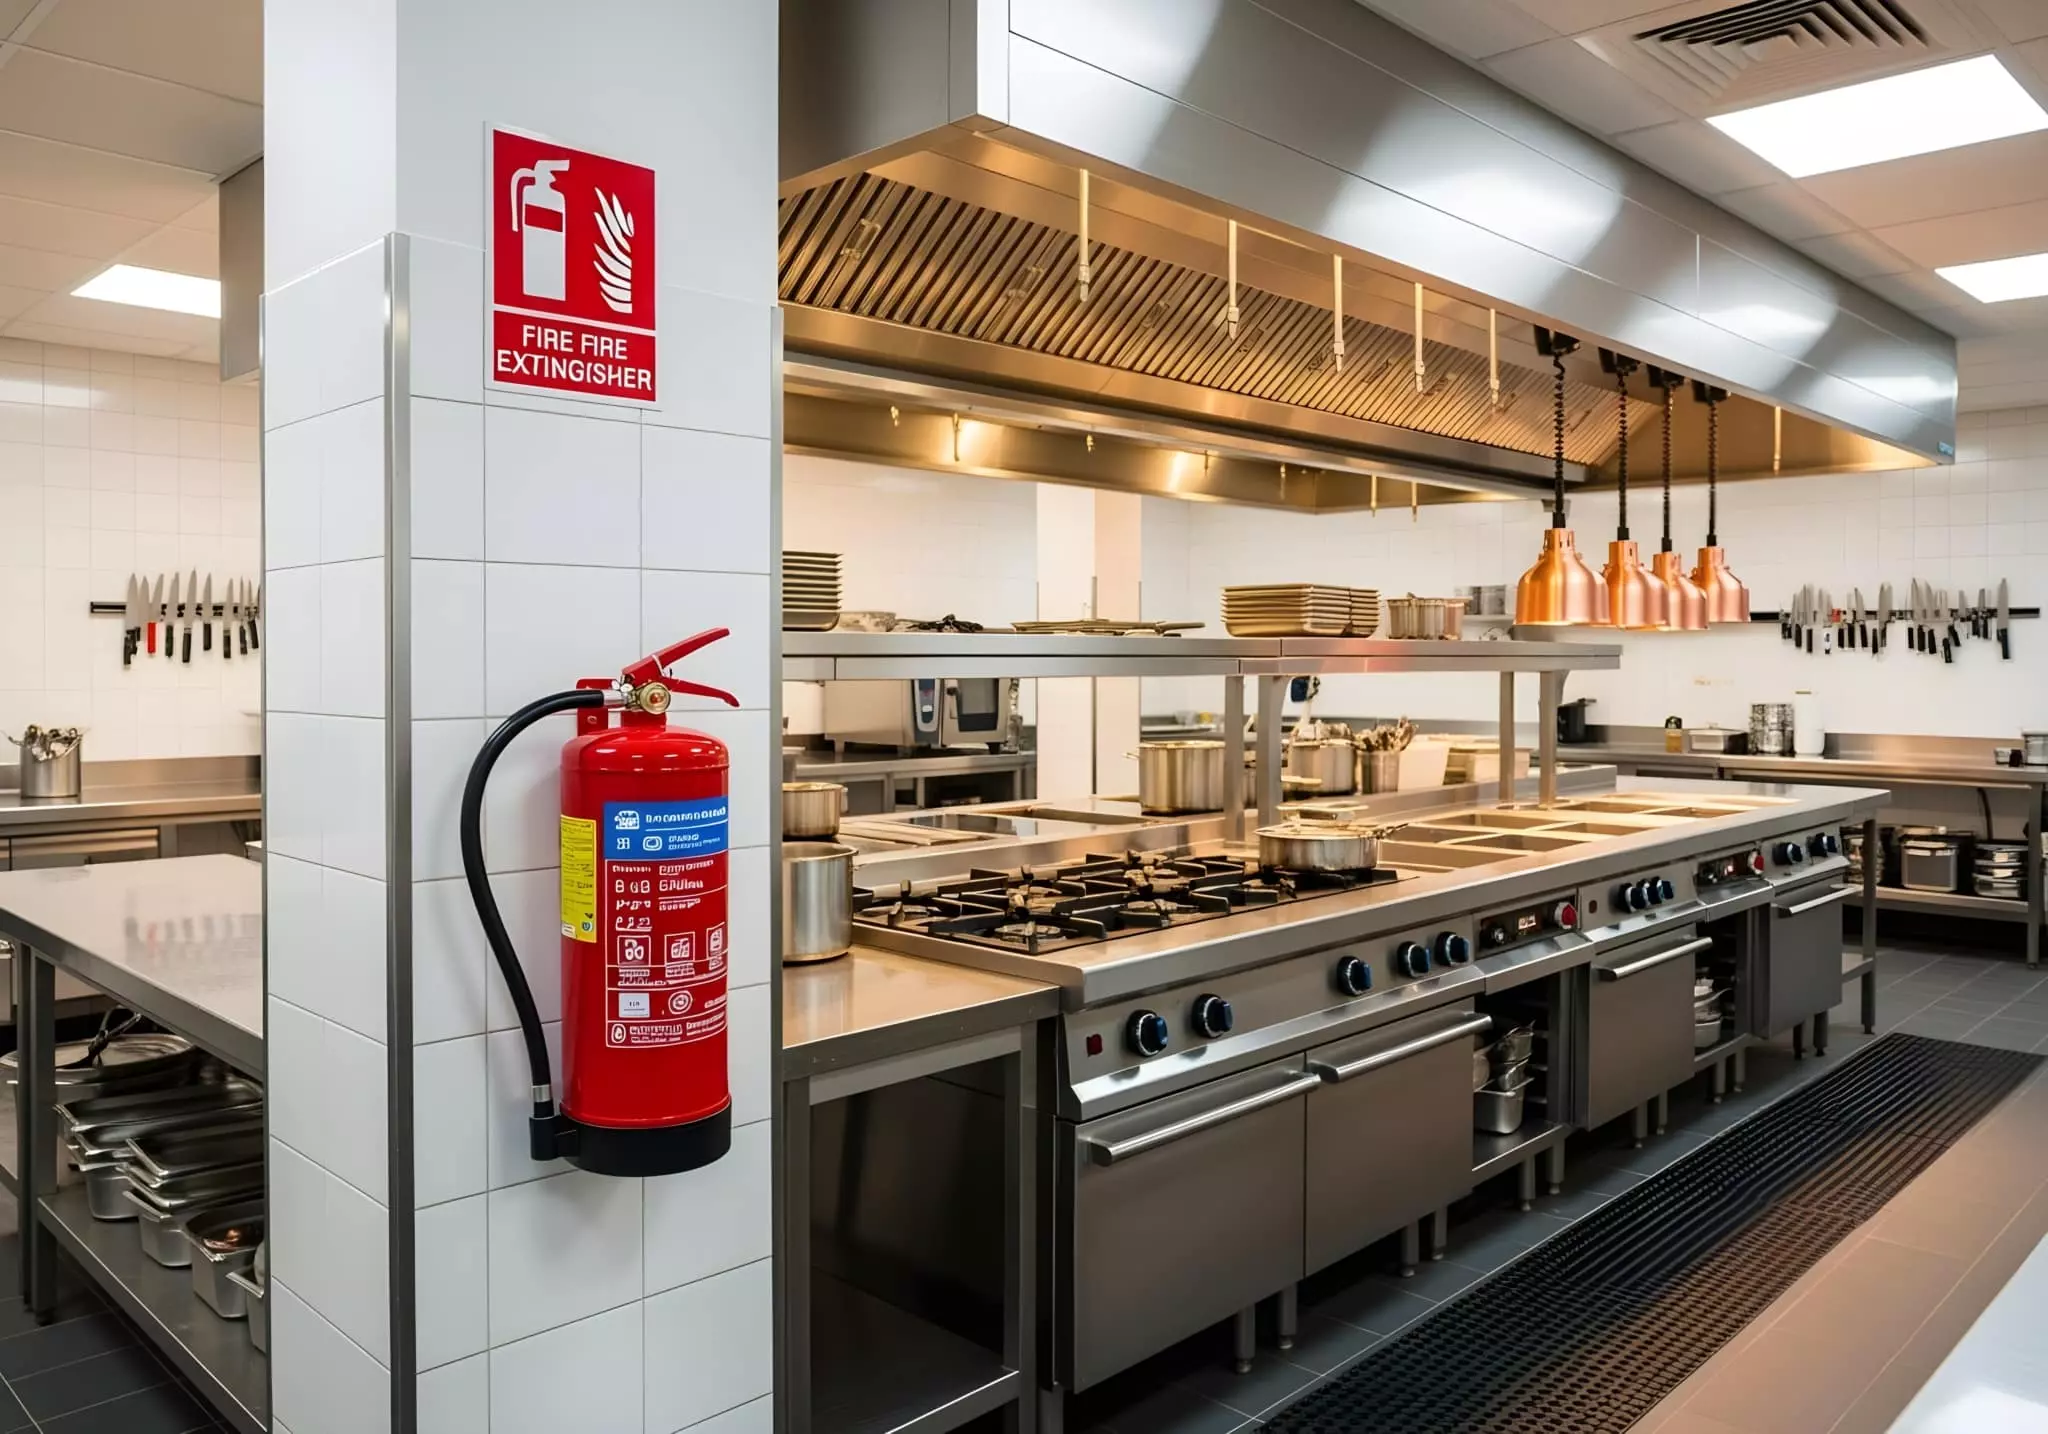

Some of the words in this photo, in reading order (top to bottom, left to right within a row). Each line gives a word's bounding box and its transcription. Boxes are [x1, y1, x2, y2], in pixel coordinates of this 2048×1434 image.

[522, 324, 574, 353] FIRE
[581, 333, 628, 360] FIRE
[497, 349, 652, 391] EXTINGISHER
